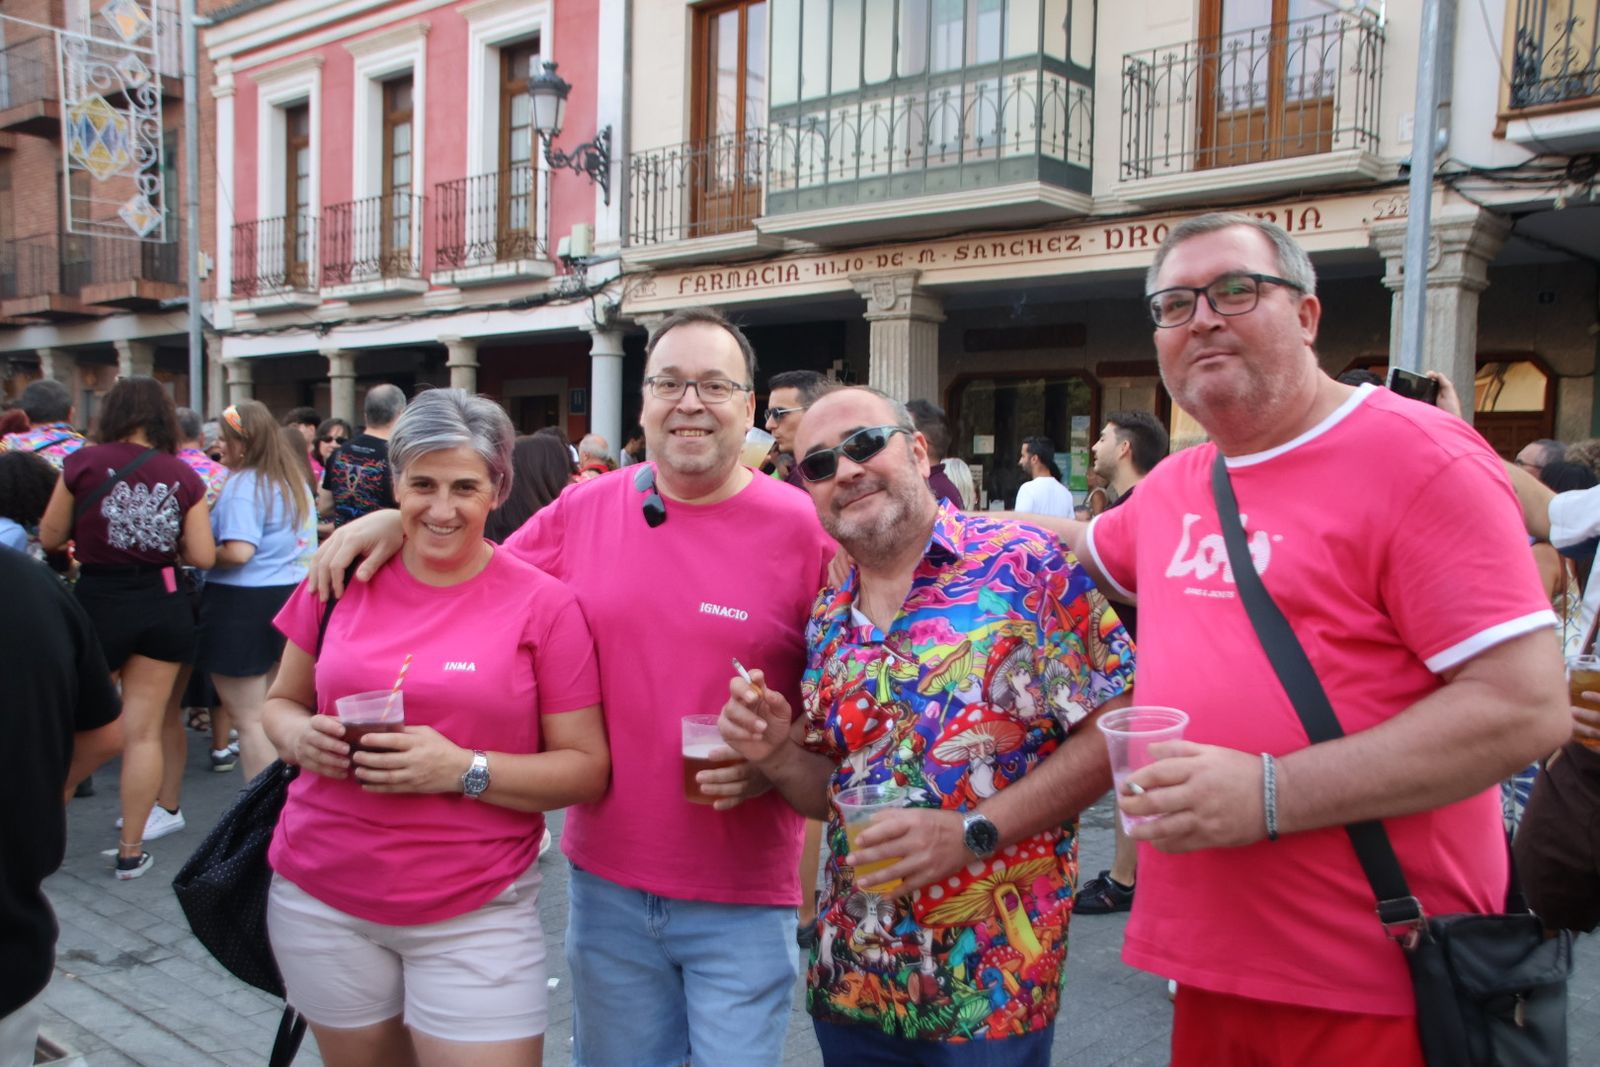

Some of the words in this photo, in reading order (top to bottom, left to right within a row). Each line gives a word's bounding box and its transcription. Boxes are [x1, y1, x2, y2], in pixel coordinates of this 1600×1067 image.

[679, 264, 799, 294] FARMACIA
[815, 258, 863, 275] HIJO
[877, 249, 903, 267] DE
[953, 235, 1082, 261] SANCHEZ
[700, 602, 748, 620] IGNACIO
[444, 661, 476, 671] INMA
